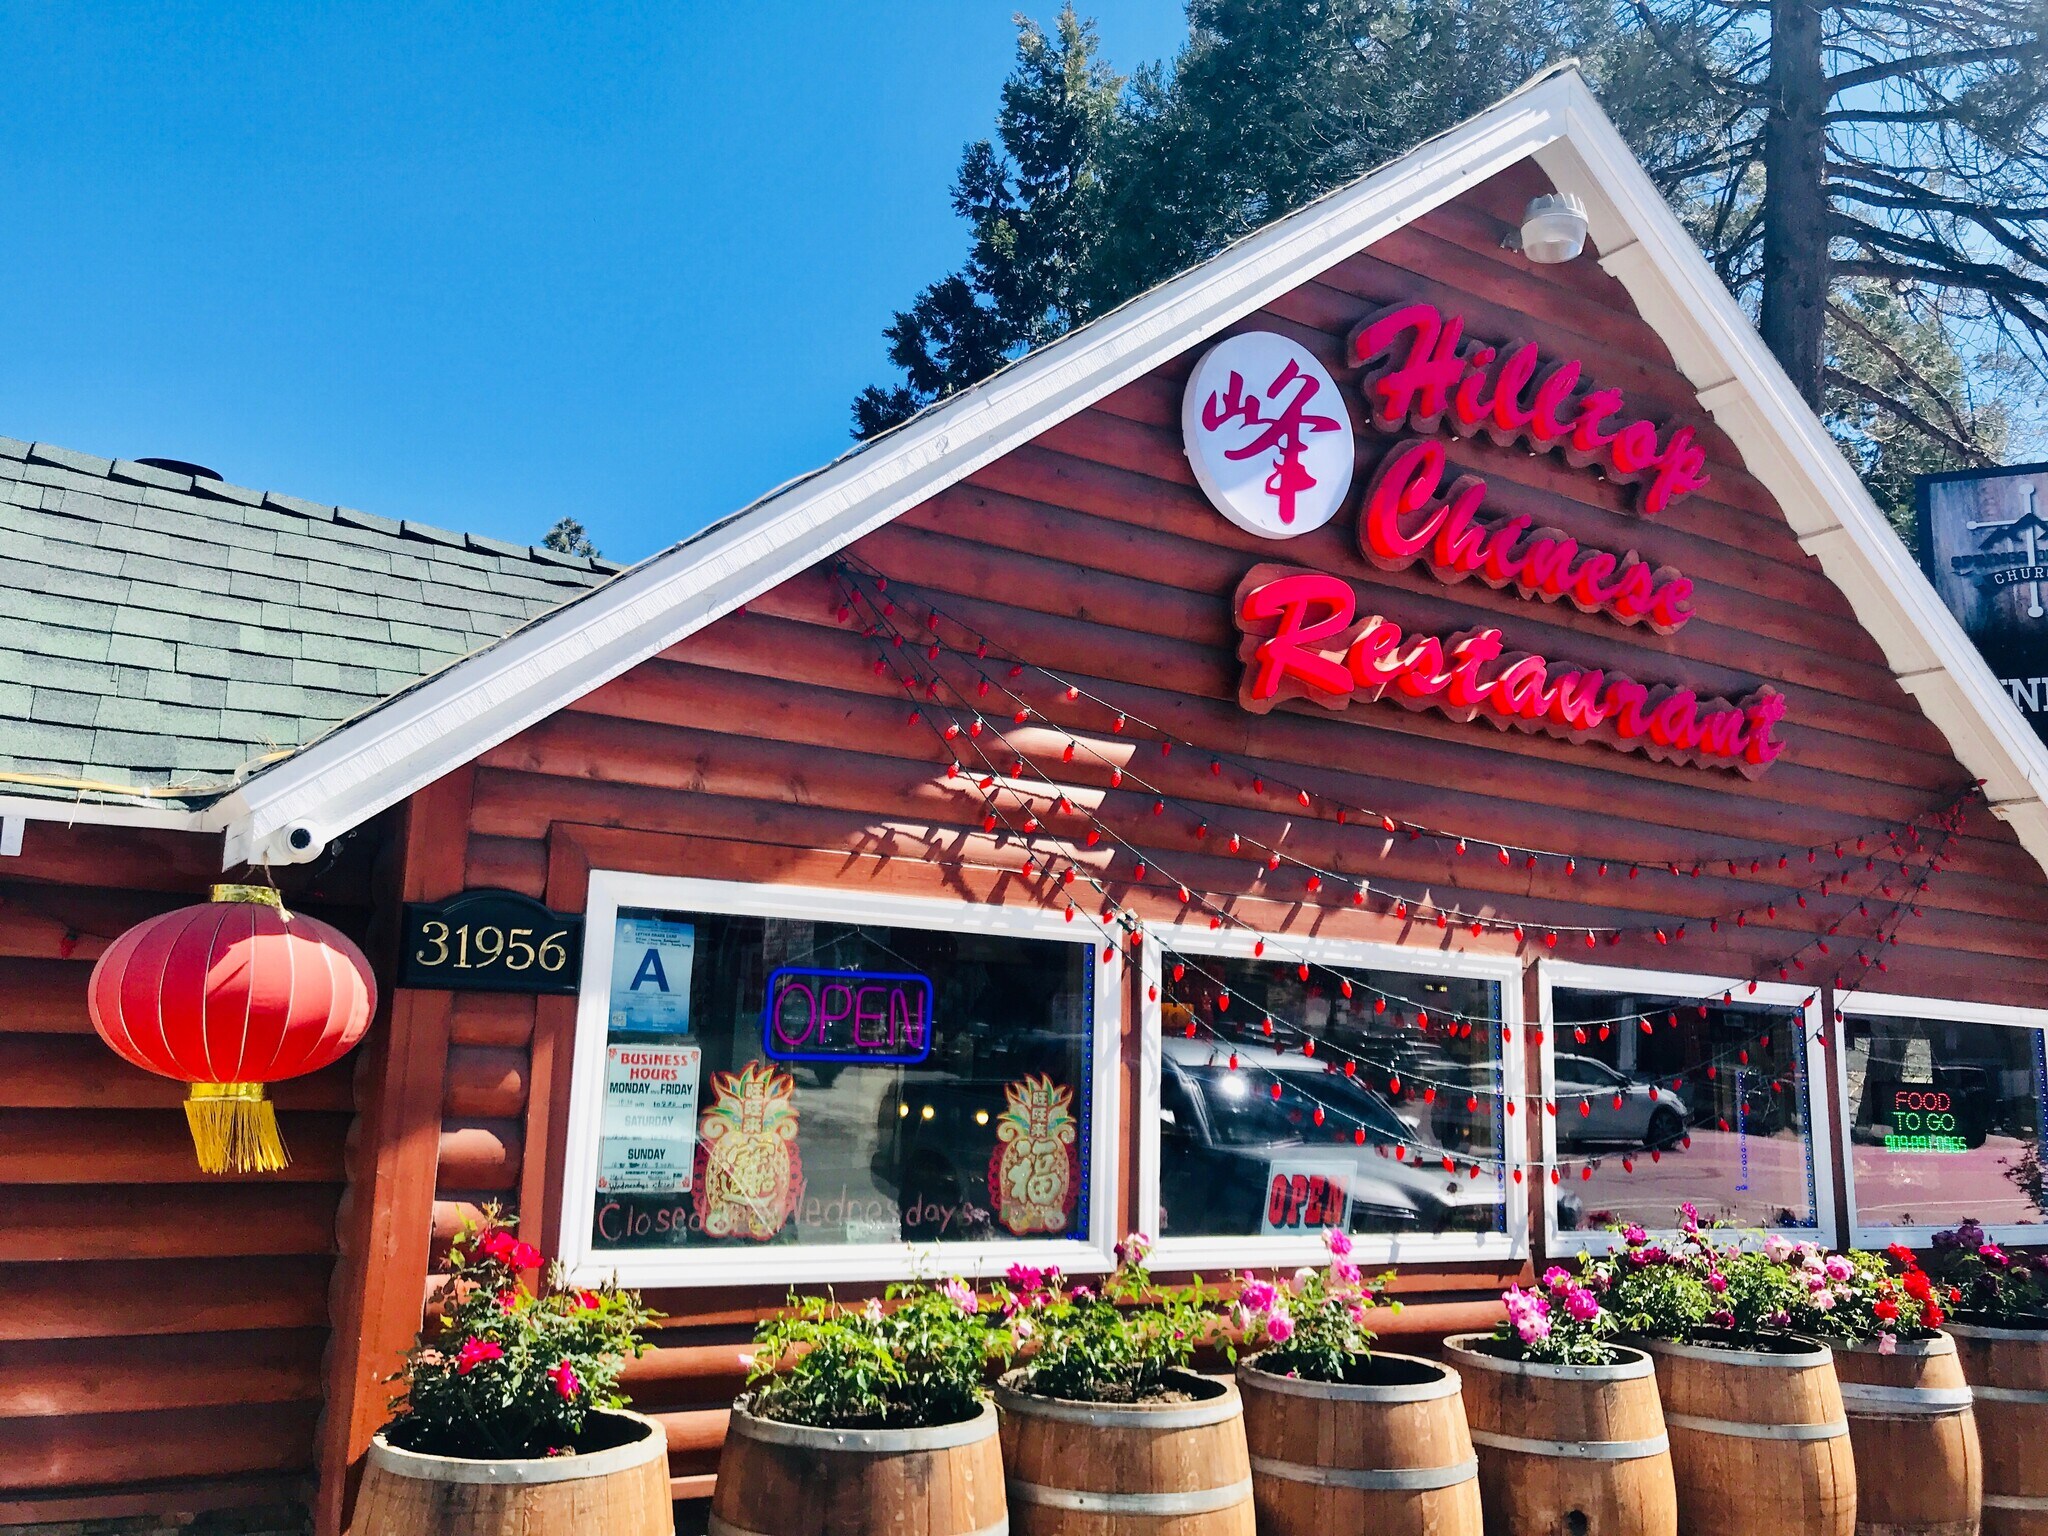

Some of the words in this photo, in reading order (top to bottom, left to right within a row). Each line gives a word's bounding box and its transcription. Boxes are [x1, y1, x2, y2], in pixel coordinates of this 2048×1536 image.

[1355, 302, 1711, 514] Hilltop
[1365, 439, 1697, 628] Chinese
[1994, 566, 2048, 585] CHUR
[1240, 574, 1787, 766] Restaurant
[416, 920, 568, 972] 31956
[629, 948, 670, 993] A
[774, 983, 924, 1048] OPEN
[609, 1082, 651, 1094] MONDAY
[660, 1083, 693, 1095] FRIDAY
[629, 1067, 678, 1081] HOURS
[1895, 1091, 1951, 1111] FOOD
[624, 1115, 674, 1127] SATURDAY
[1891, 1111, 1921, 1131] TO
[1926, 1113, 1956, 1131] GO
[628, 1148, 666, 1160] SUNDAY
[1268, 1173, 1349, 1229] OPEN
